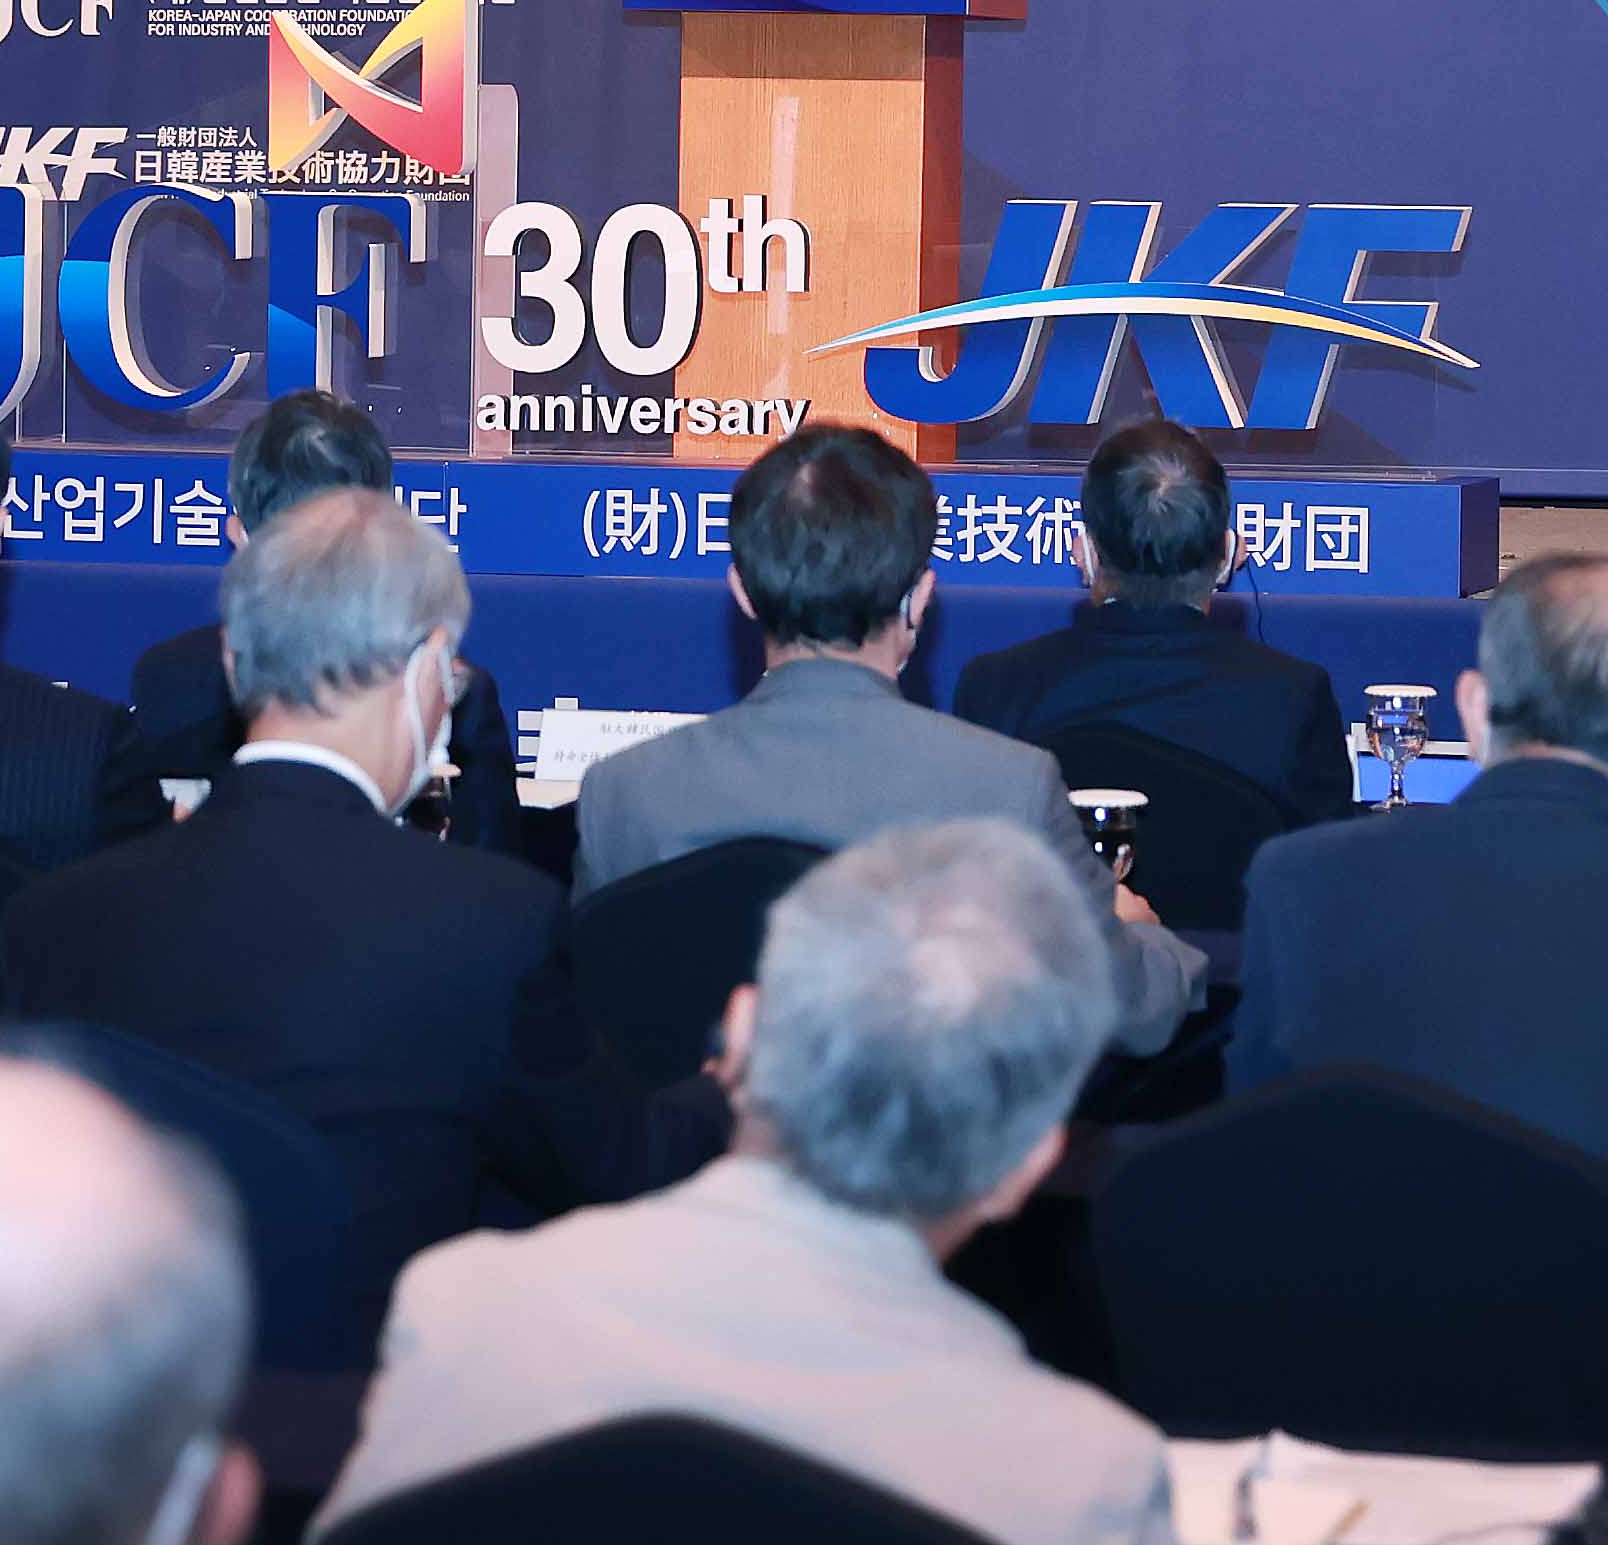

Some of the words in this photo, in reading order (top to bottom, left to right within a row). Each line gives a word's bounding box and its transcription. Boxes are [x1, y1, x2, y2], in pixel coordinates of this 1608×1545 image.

[147, 9, 241, 22] KOREA-JAPAN
[244, 9, 337, 22] COORATION
[339, 9, 414, 22] FOUNDATI
[147, 23, 175, 36] FOR
[178, 23, 243, 36] INDUSTRY
[135, 126, 258, 148] 一般財団法人
[480, 194, 812, 376] 30th
[804, 198, 1481, 431] JKF
[476, 383, 812, 441] anniversary
